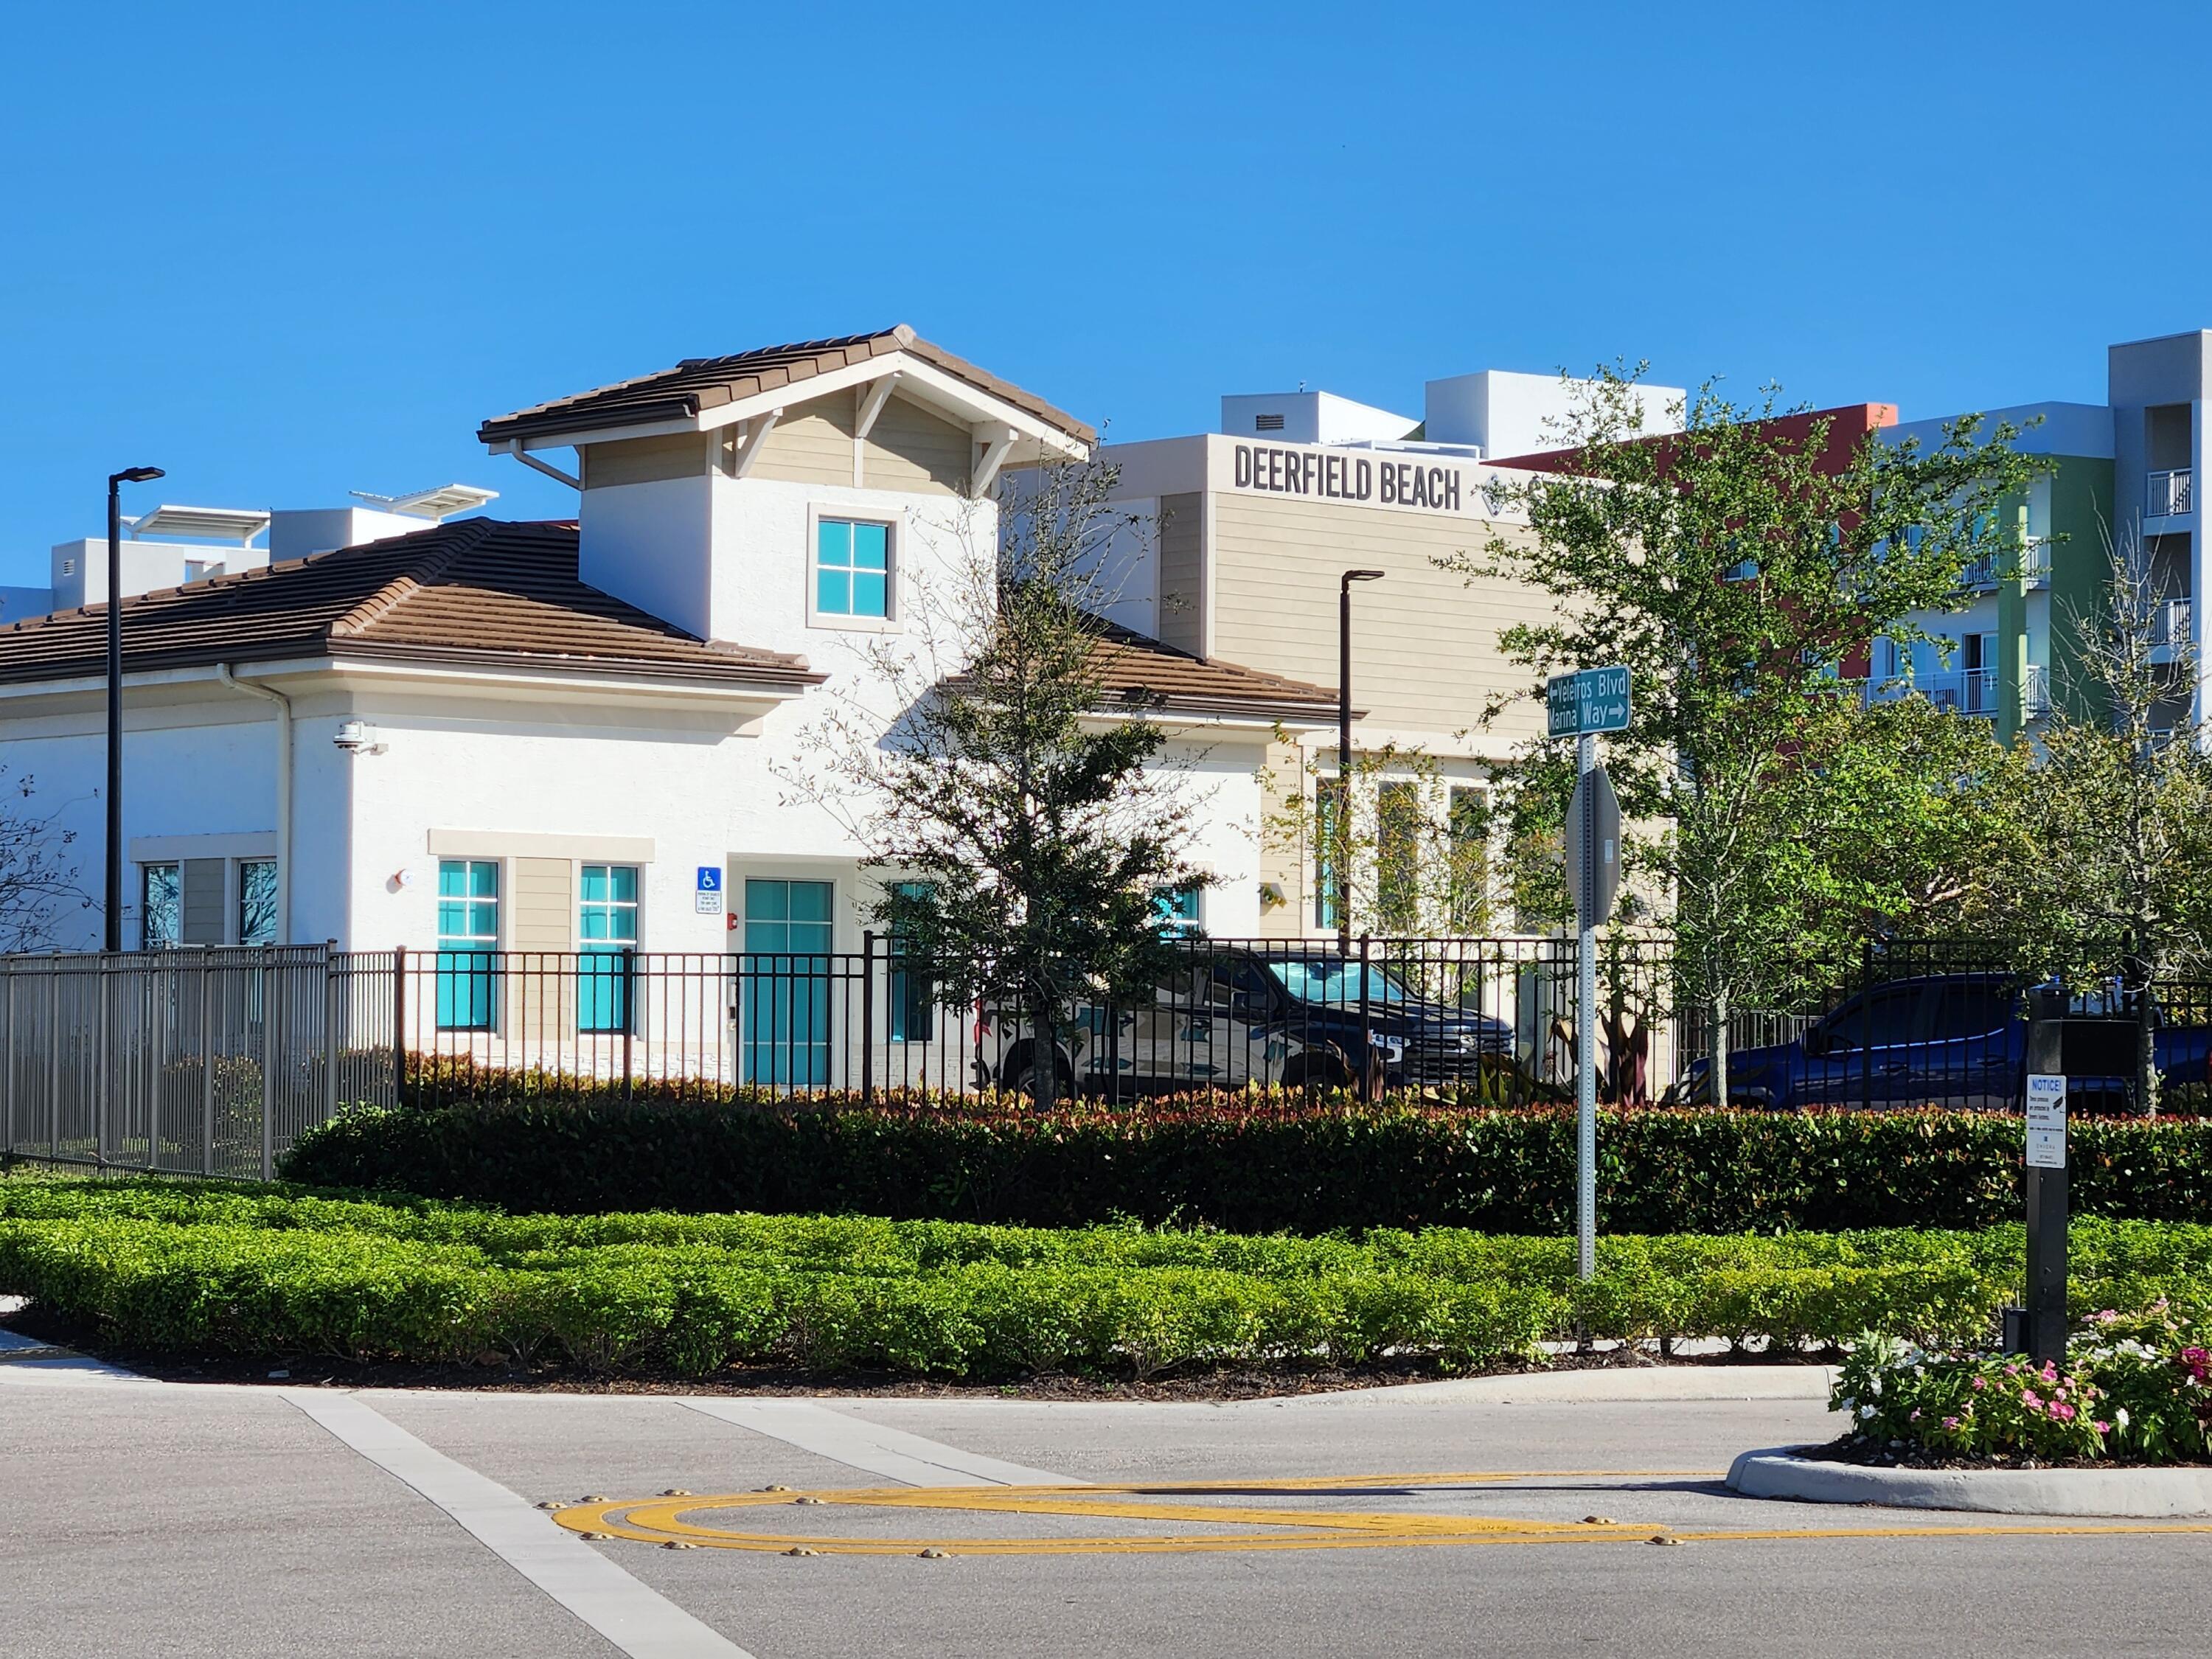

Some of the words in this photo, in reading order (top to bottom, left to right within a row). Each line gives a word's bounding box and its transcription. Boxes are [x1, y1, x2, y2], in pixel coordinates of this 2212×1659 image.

[1235, 445, 1372, 501] DEERFIELD
[1380, 462, 1461, 511] BEACH
[1599, 672, 1626, 697] Blvd
[1549, 706, 1577, 730] Marina
[1582, 701, 1608, 726] Way
